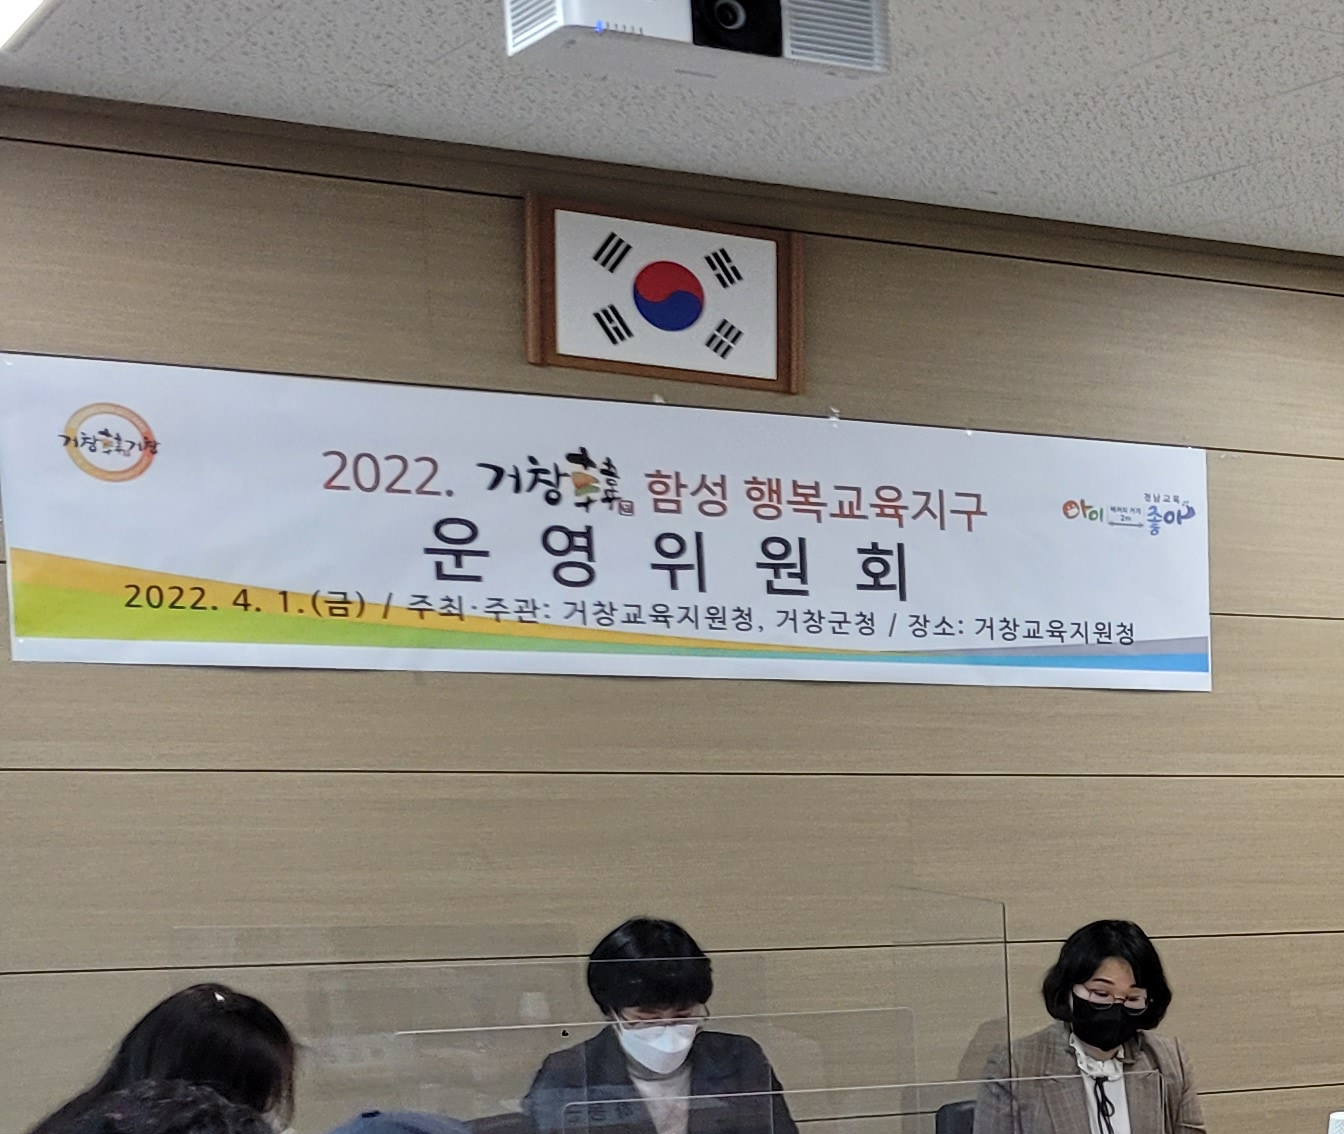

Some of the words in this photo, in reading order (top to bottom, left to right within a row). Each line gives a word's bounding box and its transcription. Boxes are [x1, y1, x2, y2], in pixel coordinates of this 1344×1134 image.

[323, 449, 455, 497] 2022.
[645, 468, 729, 517] 함성
[744, 474, 988, 532] 행복교육지구
[124, 584, 218, 612] 2022.
[232, 587, 263, 613] 4.
[278, 589, 365, 619] 1.(금)
[407, 594, 551, 625] 주최·주관:
[563, 599, 764, 633] 거창교육지원청,
[774, 607, 877, 637] 거창군청
[907, 613, 965, 640] 장소:
[974, 617, 1136, 646] 거창교육지원청
